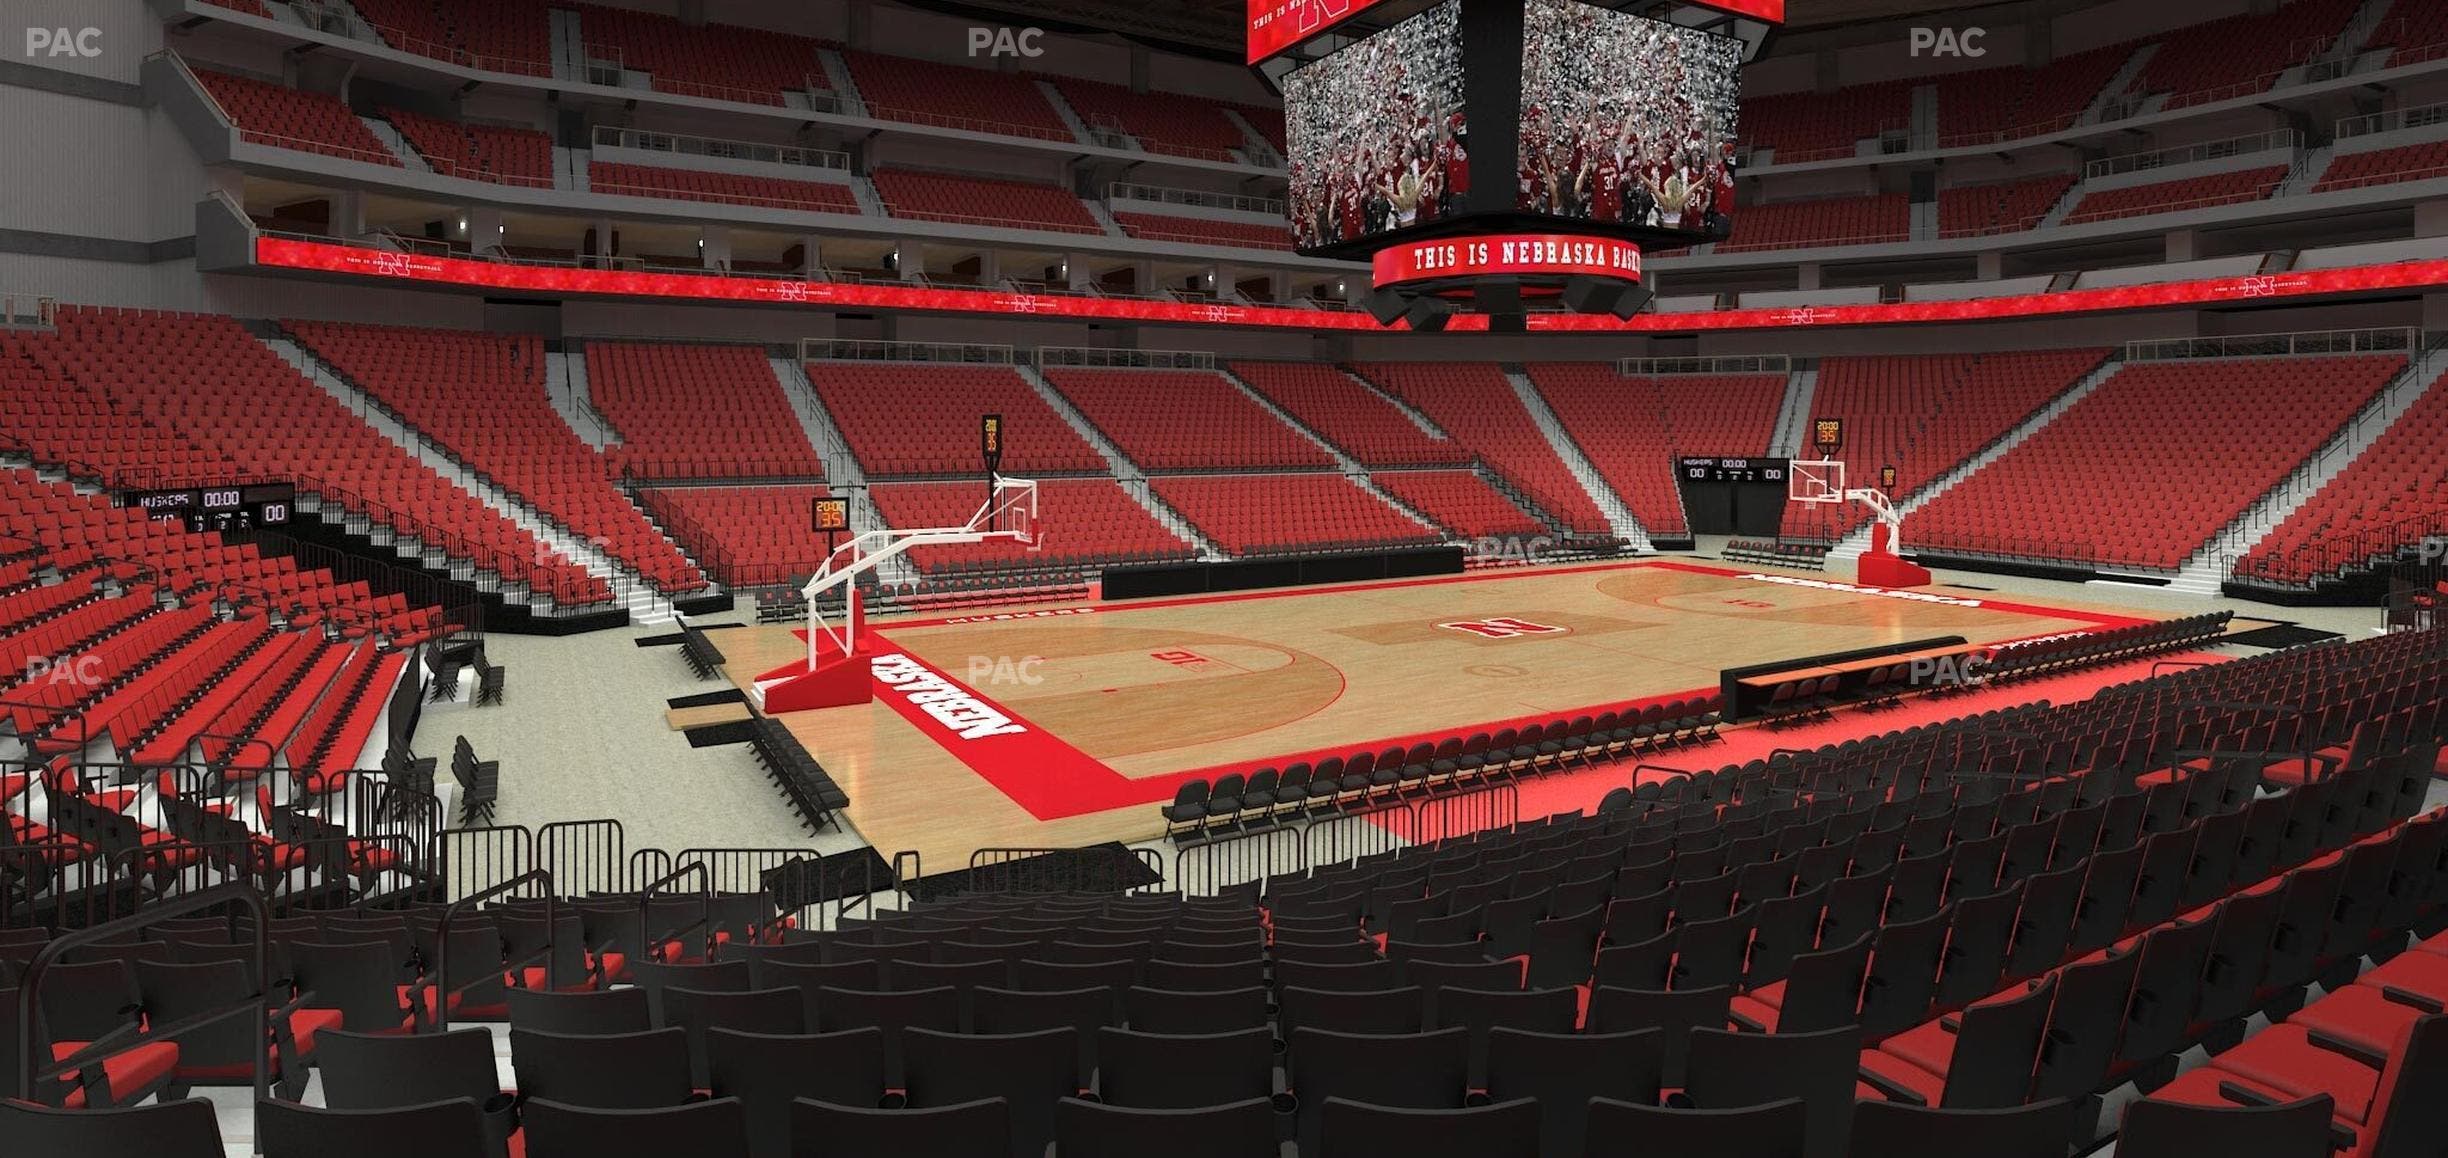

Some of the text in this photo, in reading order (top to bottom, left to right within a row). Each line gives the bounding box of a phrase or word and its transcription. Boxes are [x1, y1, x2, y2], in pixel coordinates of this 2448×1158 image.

[1253, 12, 1273, 29] THIS
[1276, 5, 1286, 17] IS
[1414, 245, 1456, 270] THIS
[1468, 243, 1488, 265] IS
[1502, 241, 1606, 266] NEBRASKA
[1817, 421, 1839, 431] 20:00
[1821, 430, 1836, 442] 35
[1690, 468, 1704, 478] 00
[1765, 469, 1780, 479] 00
[204, 491, 240, 508] 00:00
[265, 504, 285, 522] 00
[822, 512, 841, 528] 35
